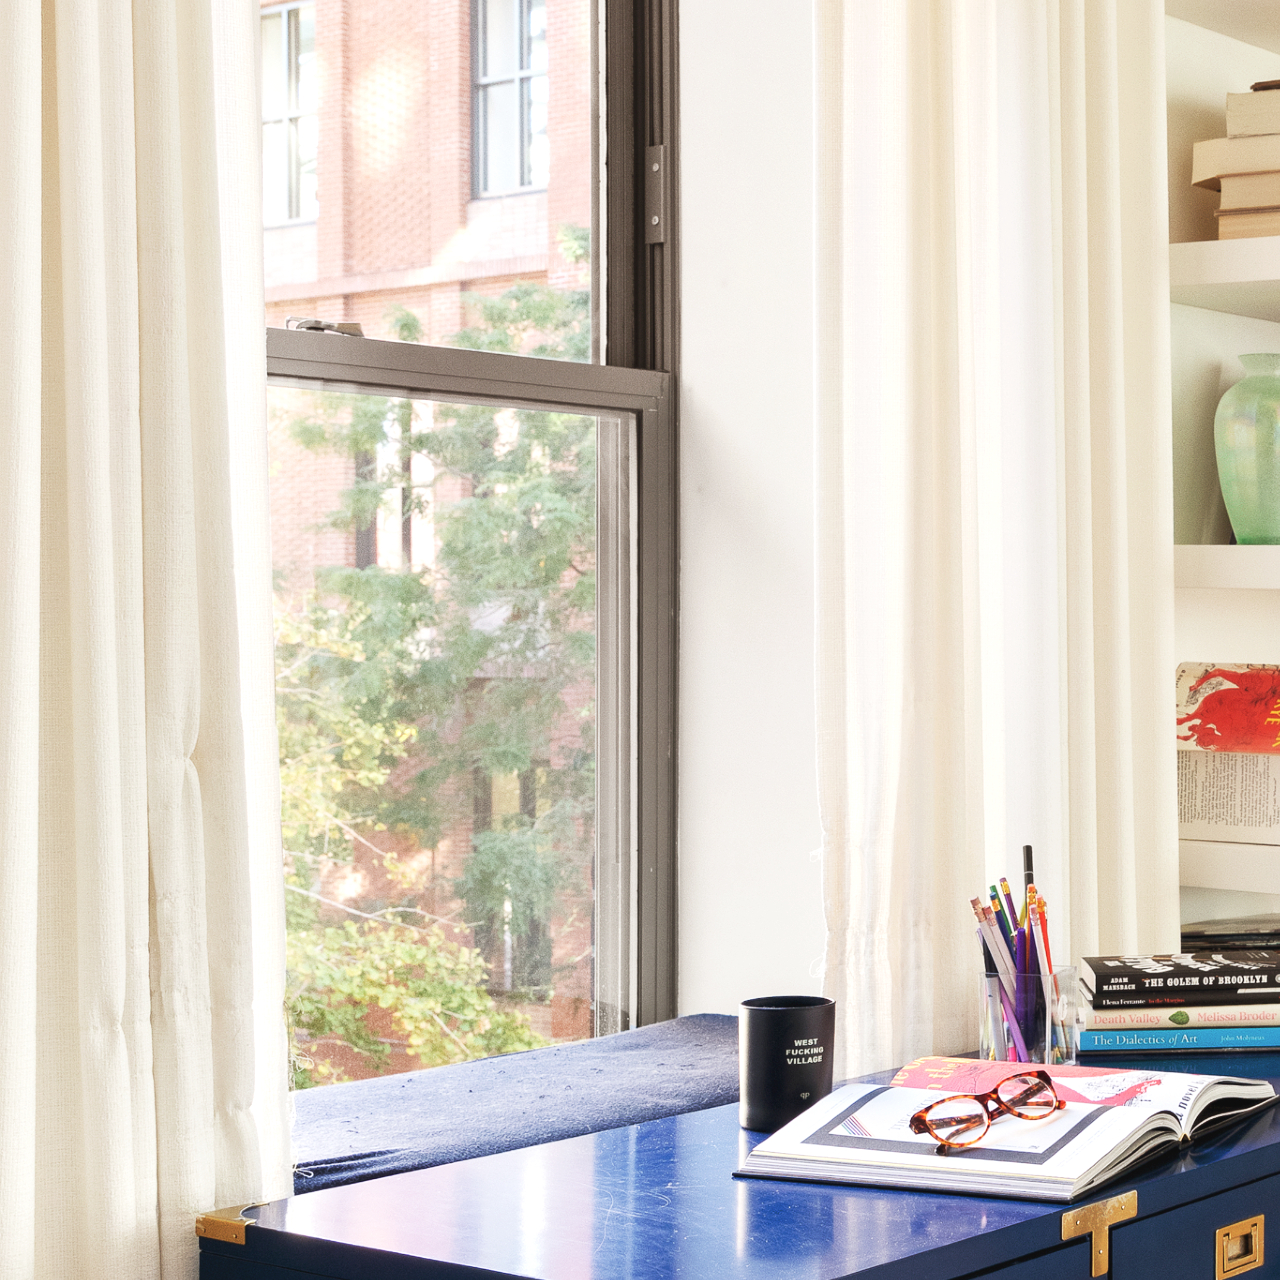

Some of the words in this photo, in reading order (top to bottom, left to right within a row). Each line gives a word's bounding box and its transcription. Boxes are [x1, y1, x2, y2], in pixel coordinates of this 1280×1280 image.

[1144, 978, 1165, 988] THE
[1166, 977, 1200, 987] GOLEM
[1202, 976, 1216, 986] OF
[1217, 974, 1268, 986] BROOKLYN
[1102, 984, 1136, 992] MANSBACH
[1093, 1015, 1127, 1025] Death
[1128, 1012, 1162, 1025] Valley
[1197, 1011, 1237, 1023] Melissa
[1239, 1010, 1278, 1022] Broder
[794, 1038, 818, 1047] WEST
[1092, 1034, 1114, 1046] The
[1116, 1033, 1166, 1045] Dialectics
[1168, 1031, 1179, 1045] of
[1181, 1031, 1198, 1044] Art
[1220, 1034, 1235, 1043] John
[785, 1046, 824, 1056] FUCKING
[786, 1055, 823, 1065] VILLAGE
